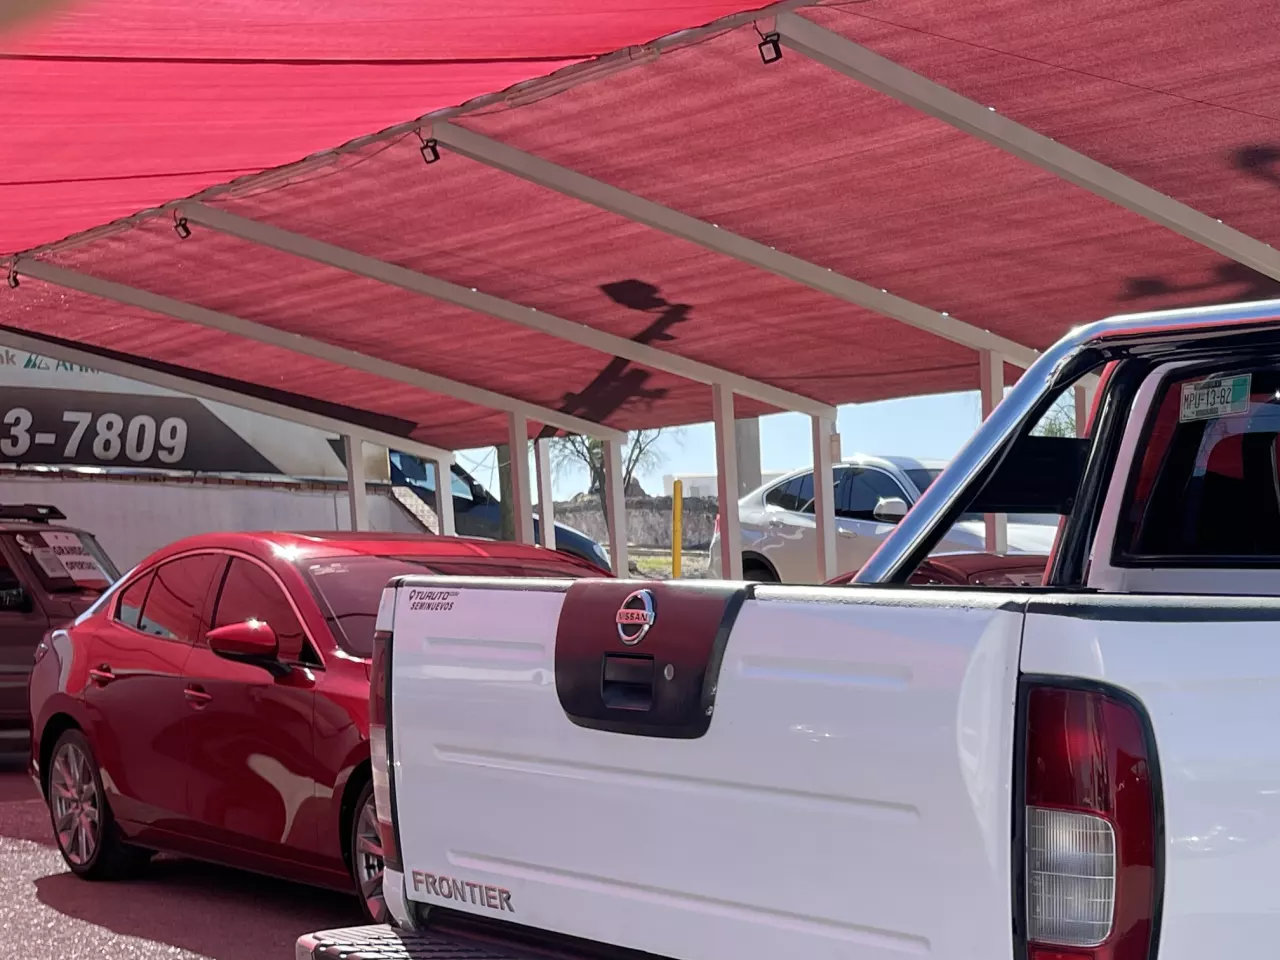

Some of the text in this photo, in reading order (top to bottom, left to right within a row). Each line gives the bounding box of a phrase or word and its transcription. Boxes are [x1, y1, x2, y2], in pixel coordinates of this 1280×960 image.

[0, 406, 188, 464] 3-7809
[410, 602, 454, 610] SEMINUEVOS
[619, 611, 648, 621] NISSAN
[412, 868, 515, 913] FRONTIER
